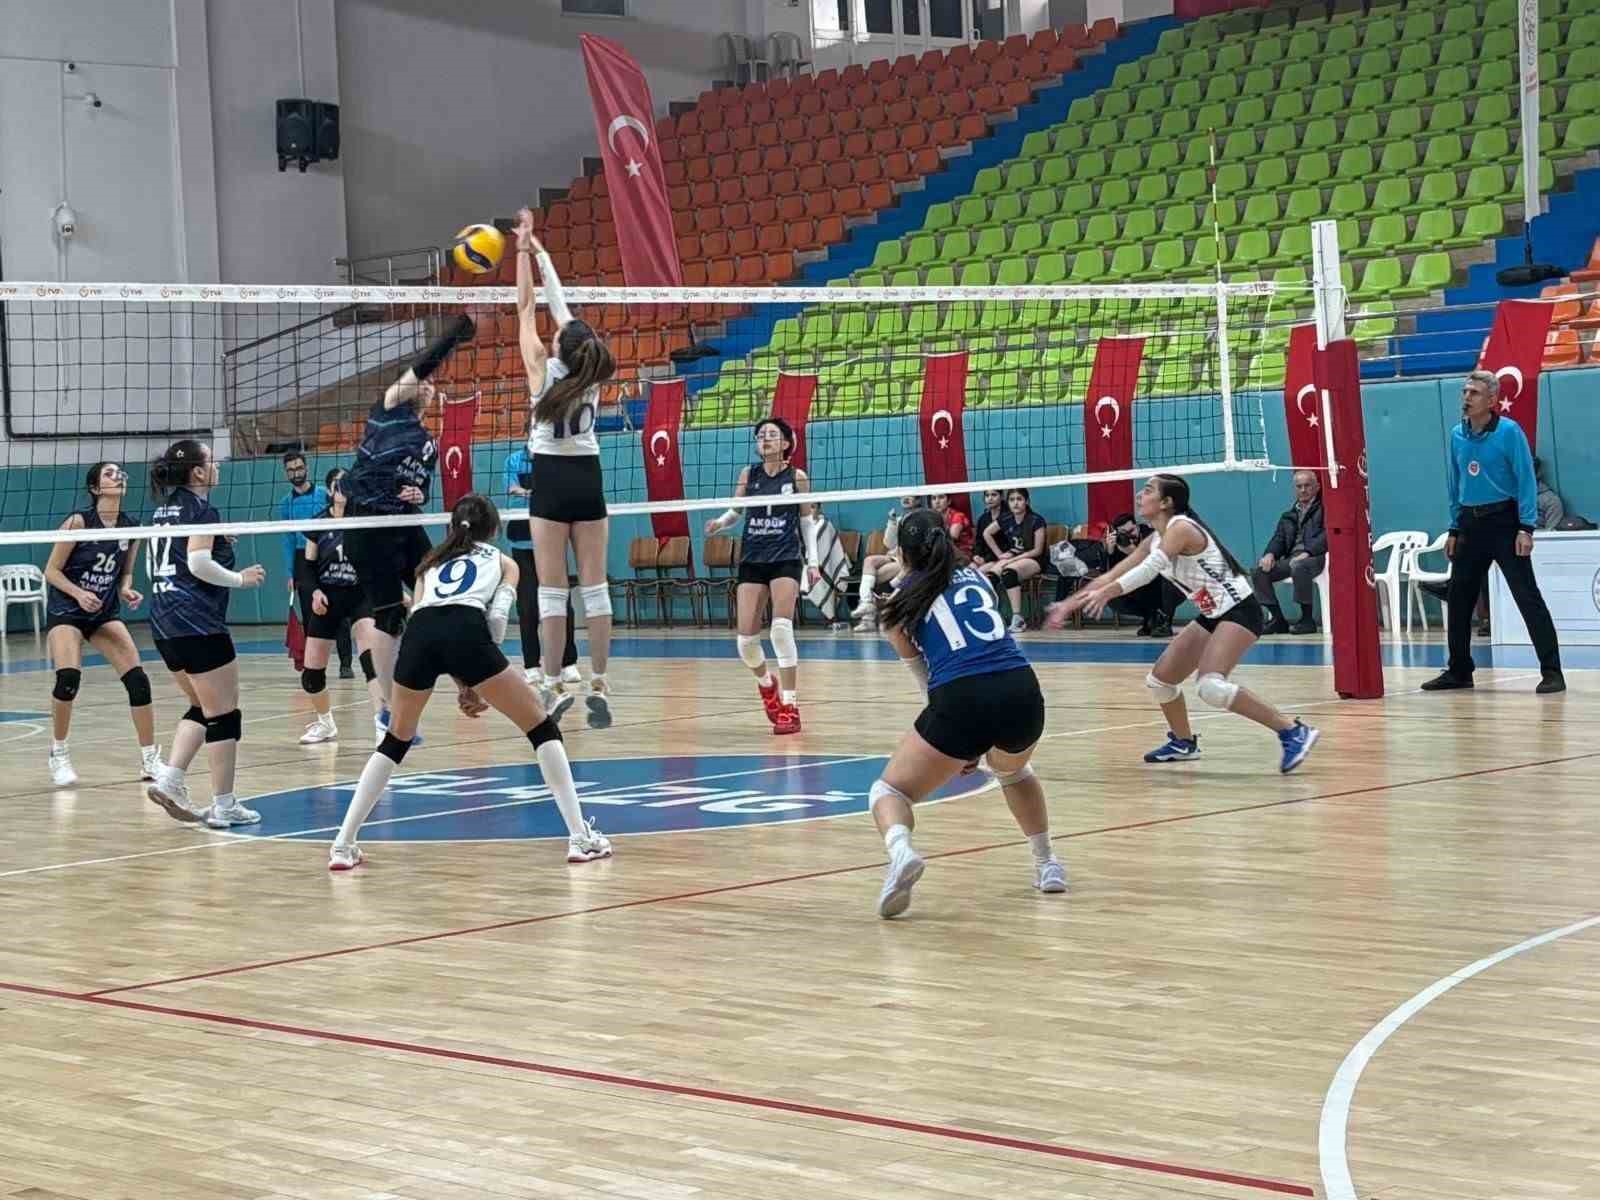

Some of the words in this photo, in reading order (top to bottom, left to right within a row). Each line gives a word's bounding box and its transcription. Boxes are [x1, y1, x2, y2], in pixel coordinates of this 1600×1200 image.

[92, 552, 117, 573] 26
[434, 559, 477, 599] 9
[925, 585, 1005, 651] 13
